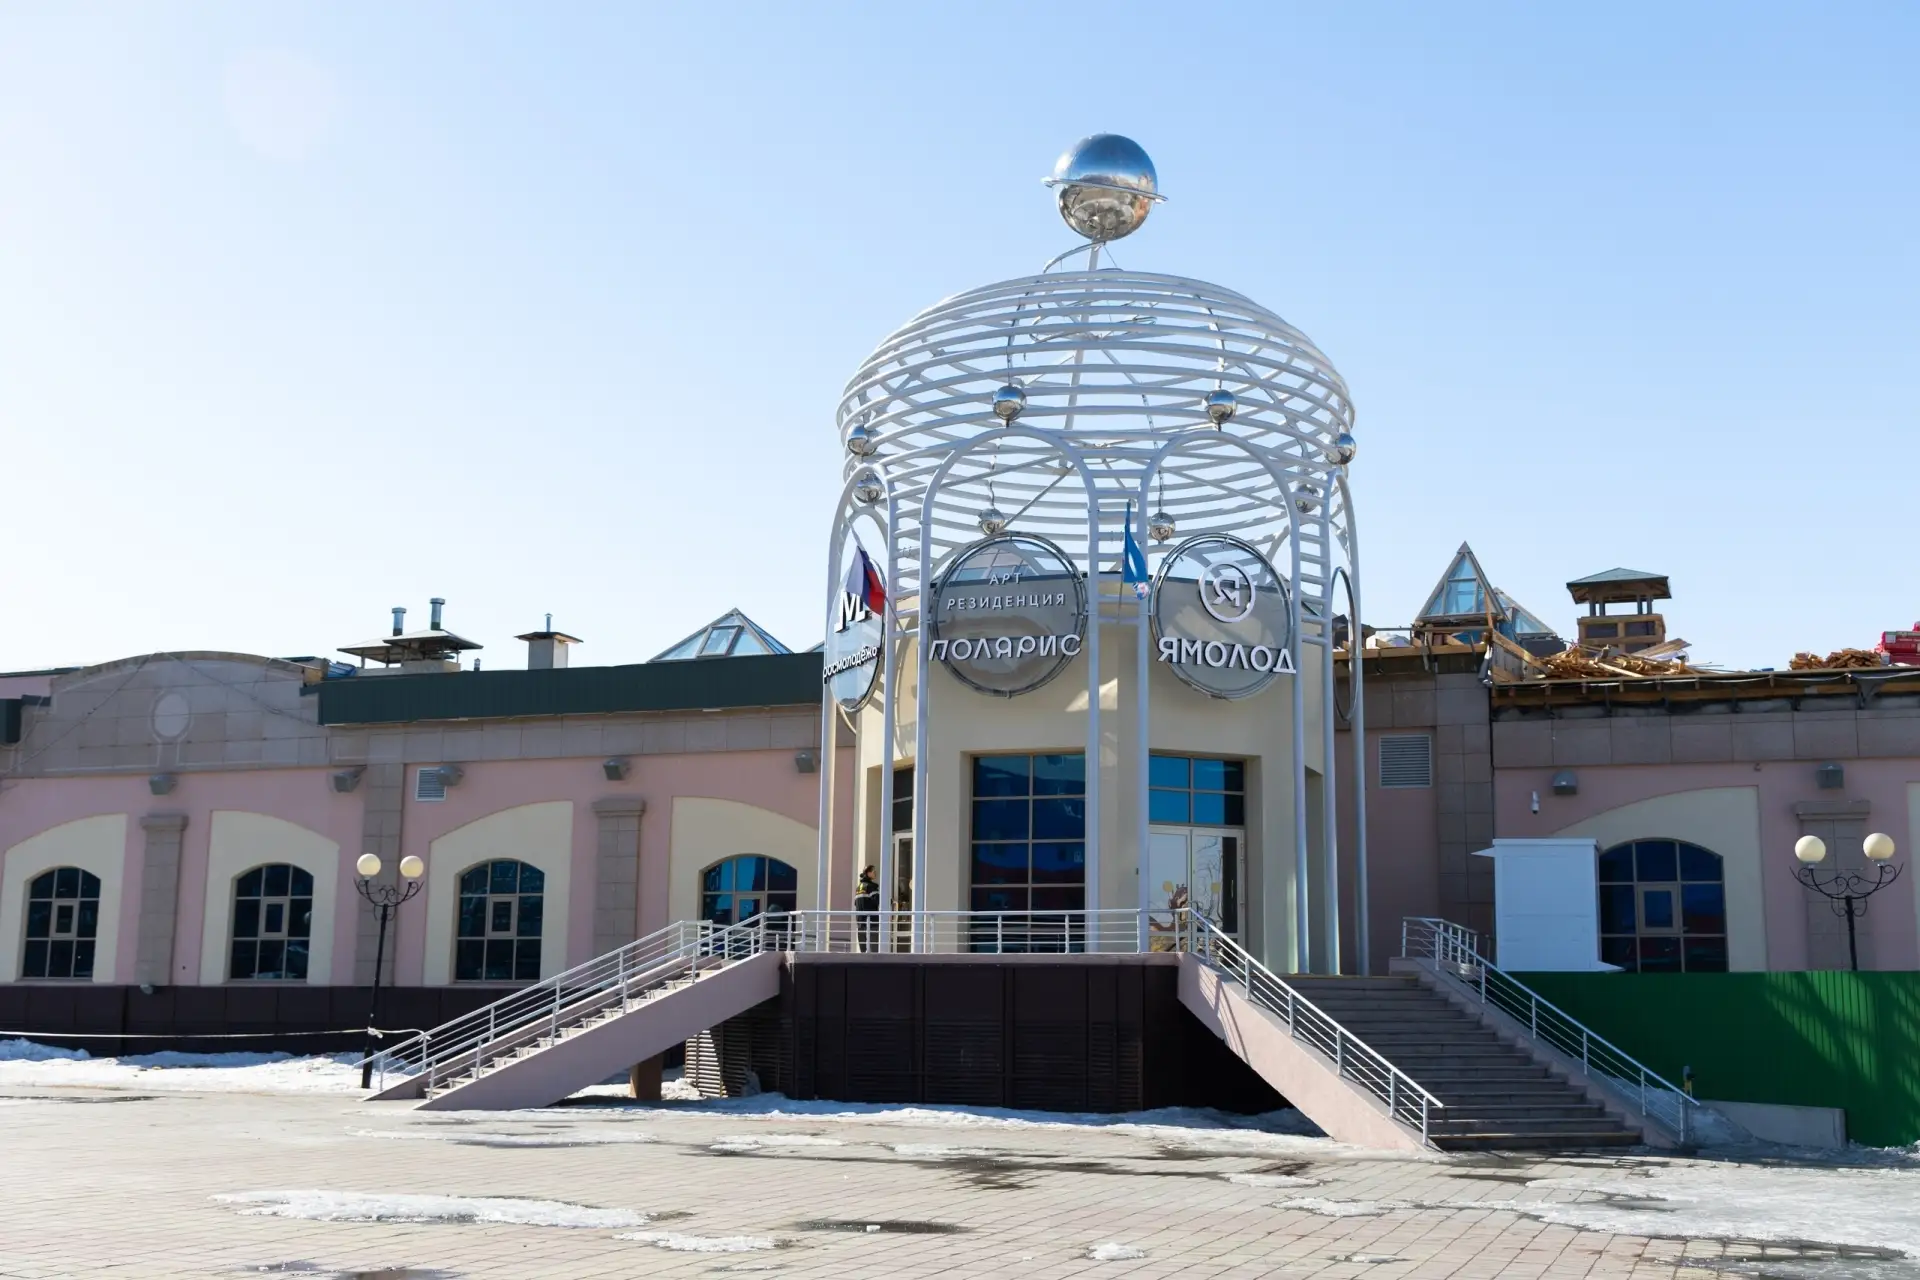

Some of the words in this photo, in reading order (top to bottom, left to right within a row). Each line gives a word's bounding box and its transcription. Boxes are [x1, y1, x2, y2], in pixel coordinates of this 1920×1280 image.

[989, 572, 1022, 585] АРТ
[947, 593, 1065, 610] РЕЗИДЕНЦИЯ
[928, 634, 1081, 661] ПОЛЯРИС
[1157, 636, 1297, 674] ЯМОЛОД
